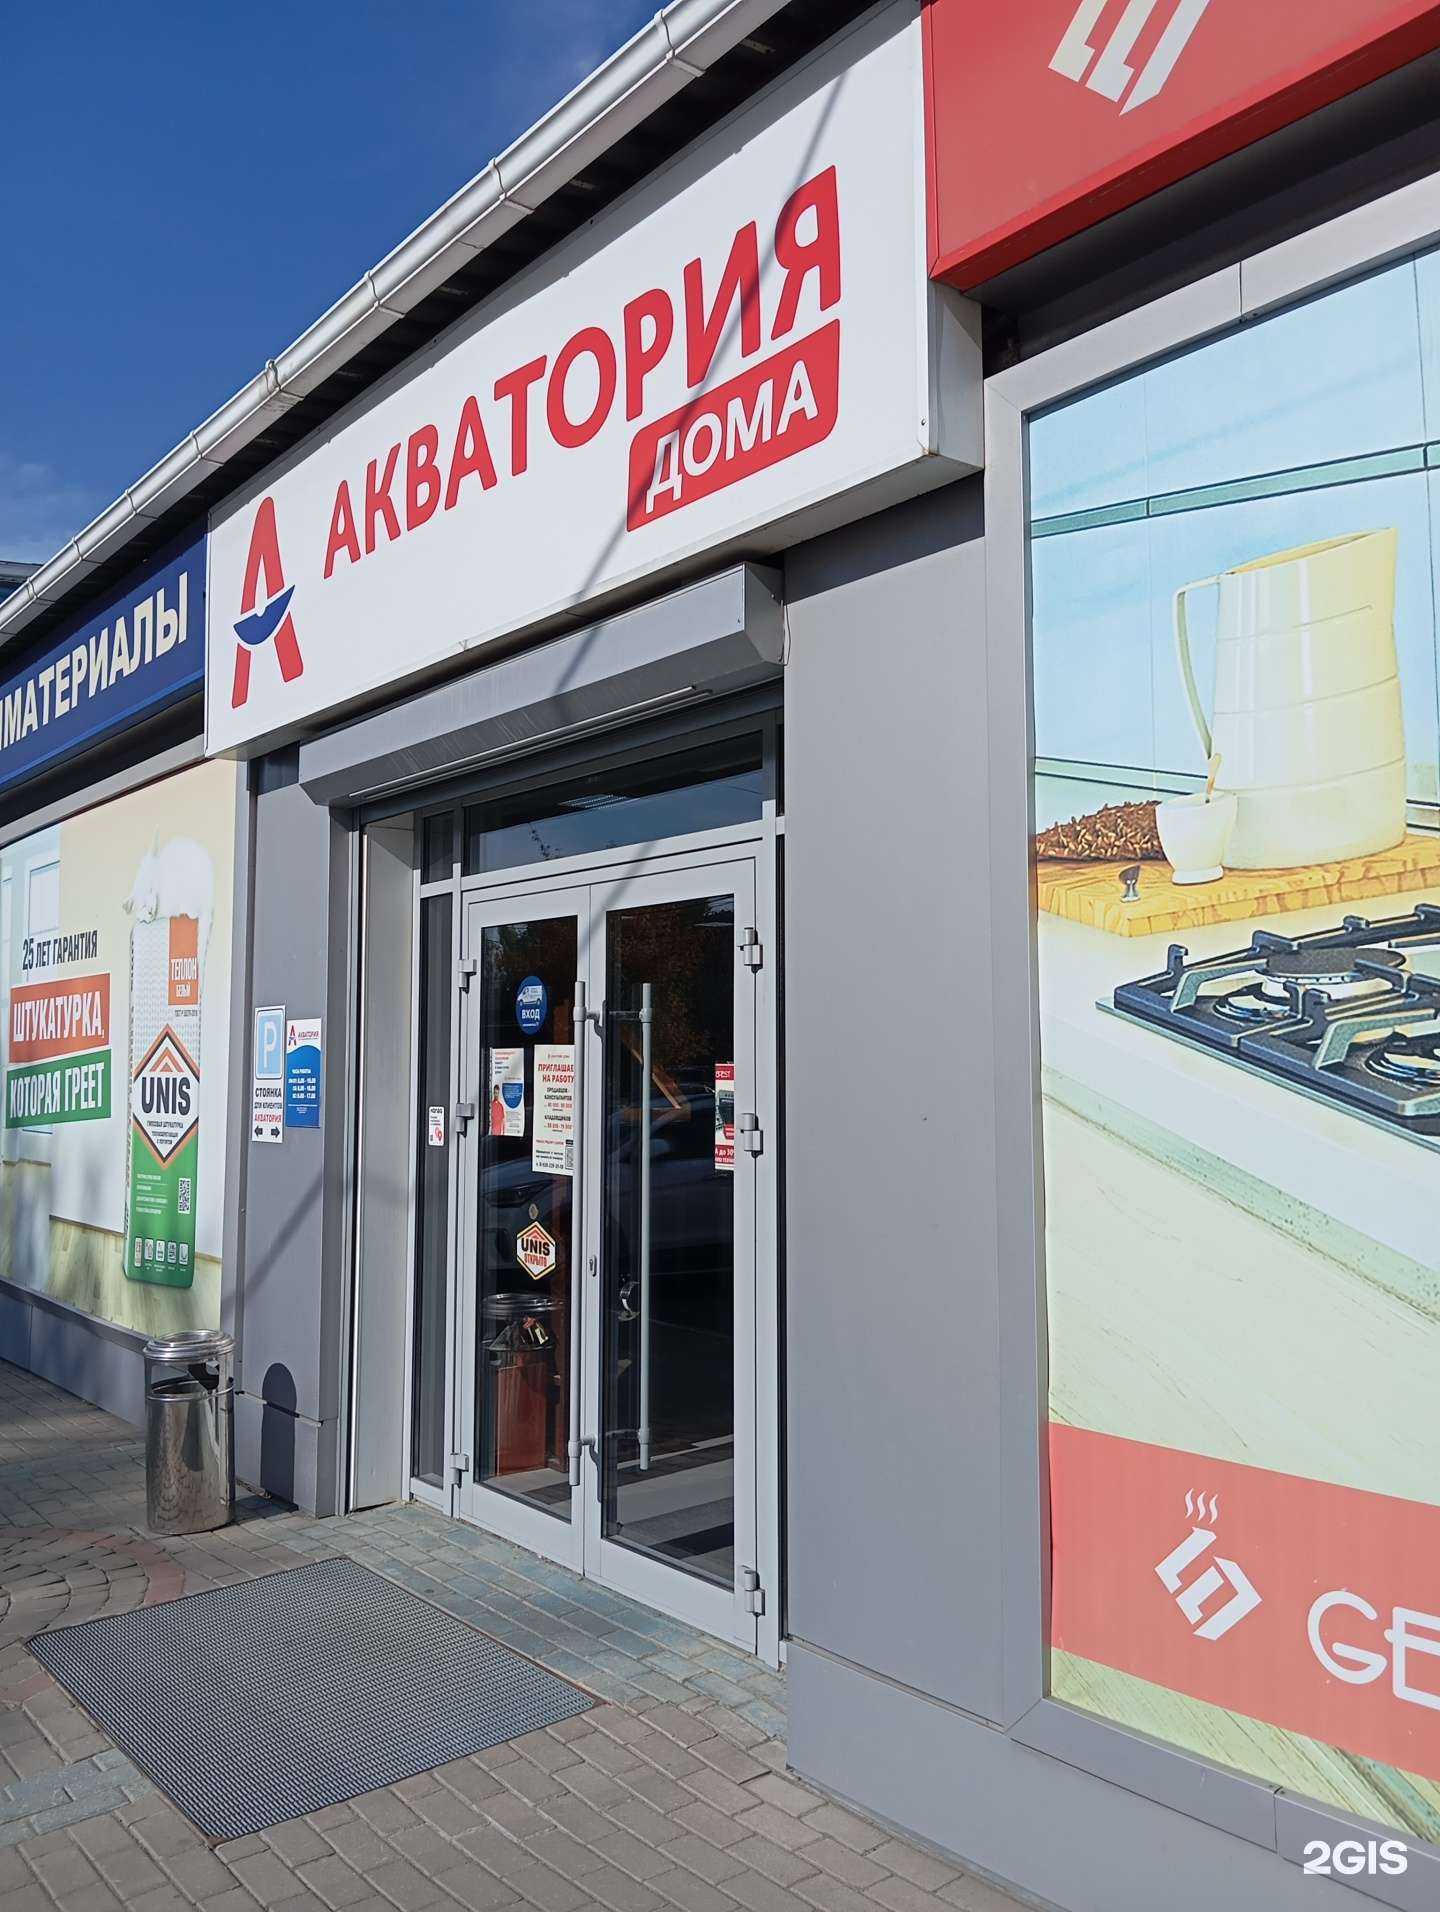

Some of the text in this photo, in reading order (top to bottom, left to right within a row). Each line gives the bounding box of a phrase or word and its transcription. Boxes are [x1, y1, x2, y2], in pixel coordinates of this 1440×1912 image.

[324, 165, 841, 579] АКВАТОРИЯ
[645, 358, 819, 513] ДОМА
[22, 929, 98, 971] 25 ЛЕТ ГАРАНТИЯ
[521, 1008, 541, 1021] ВХОД
[538, 1064, 574, 1072] ПРИГЛАШАЕ
[10, 1061, 105, 1118] КОТОРАЯ ГРЕЕТ
[141, 1076, 191, 1115] UNIS
[255, 1087, 282, 1098] СТОЯНКА
[521, 1238, 551, 1257] UNIS
